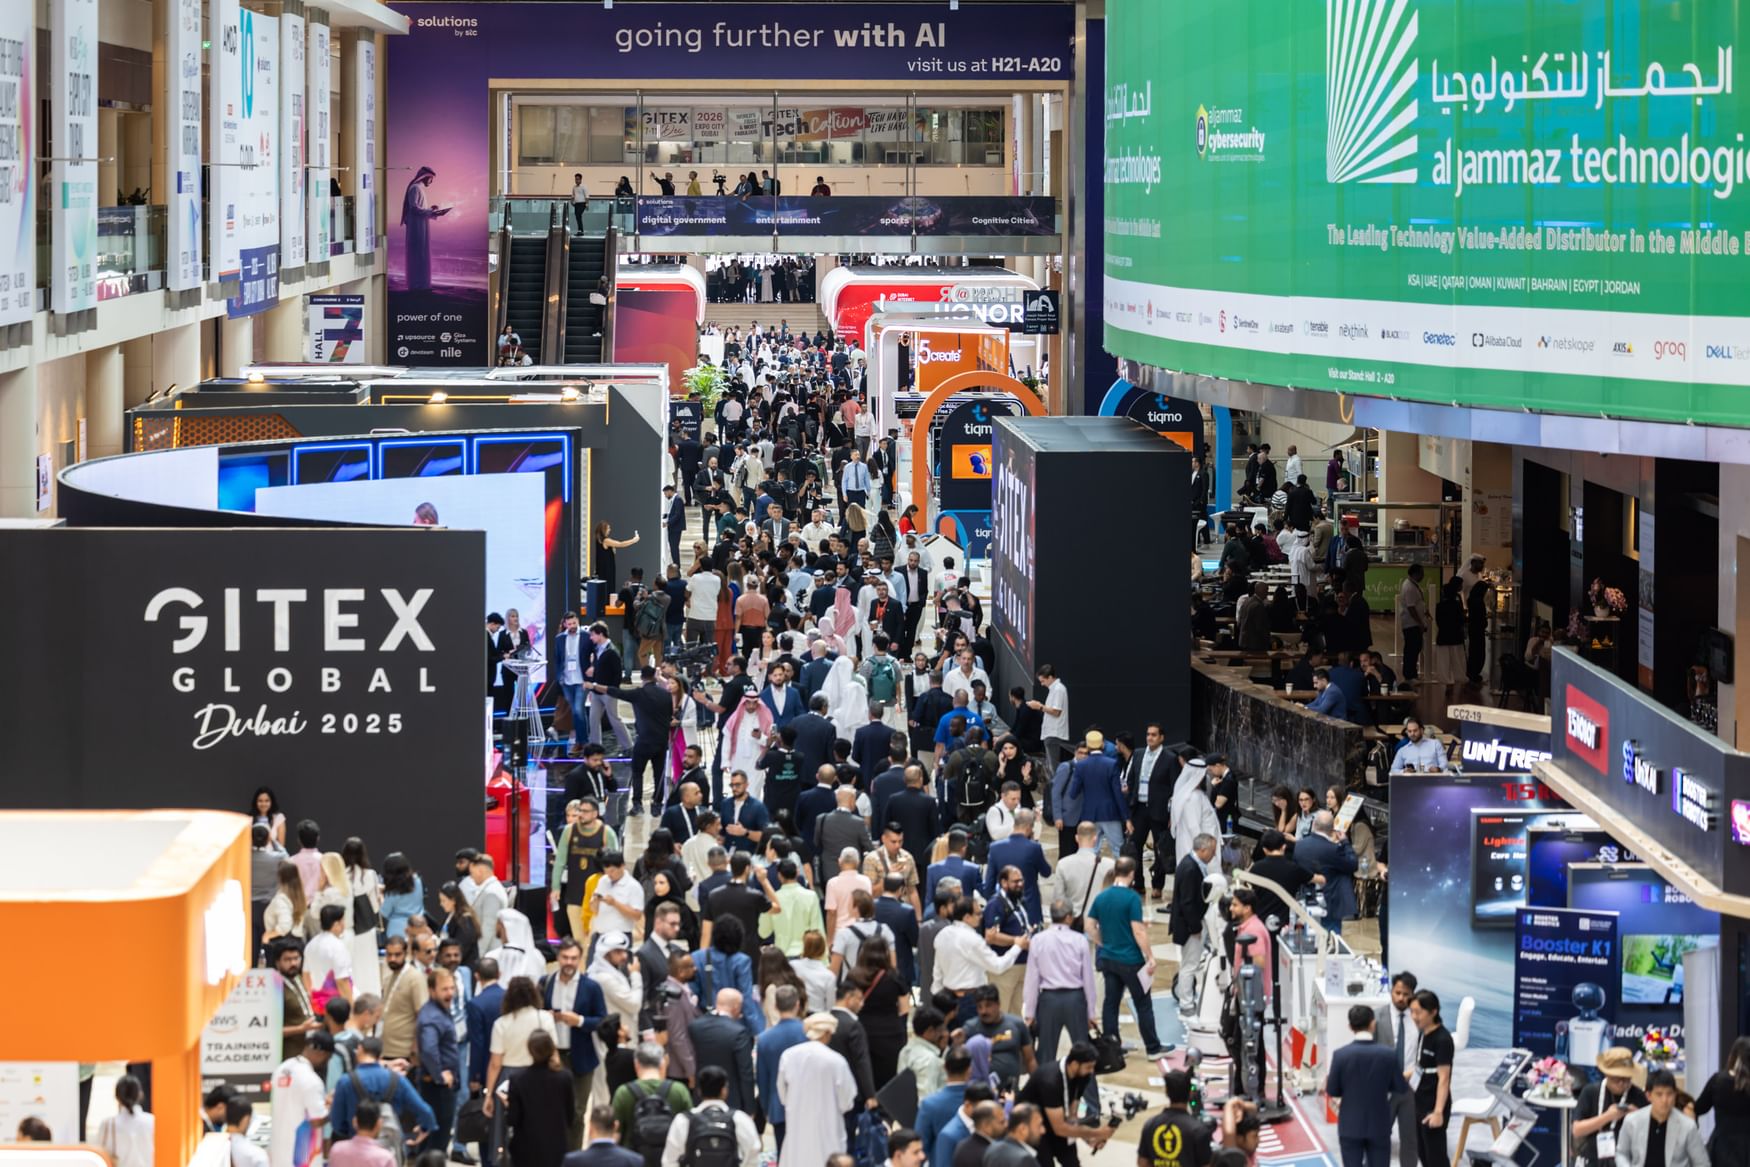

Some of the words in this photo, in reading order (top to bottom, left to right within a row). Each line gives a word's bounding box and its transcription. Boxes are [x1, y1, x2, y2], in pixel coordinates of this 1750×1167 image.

[417, 15, 478, 28] solutions
[454, 29, 464, 38] by
[465, 28, 478, 37] stc
[615, 22, 702, 53] going
[712, 23, 825, 48] further
[833, 23, 906, 48] with
[914, 23, 946, 48] AI
[907, 58, 943, 73] visit
[948, 61, 967, 73] us
[970, 59, 988, 73] at
[991, 57, 1062, 73] H21-A20
[642, 112, 688, 125] GITEX
[697, 112, 723, 122] 2026
[1208, 126, 1265, 154] cybersecurity
[642, 214, 671, 226] digital
[673, 215, 727, 226] government
[755, 215, 821, 225] entertainment
[880, 216, 909, 226] sports
[972, 215, 1009, 226] Cognitive
[1010, 215, 1035, 225] Cities
[1327, 223, 1345, 246] The
[1347, 224, 1388, 252] Leading
[1390, 225, 1455, 254] Technology
[1457, 226, 1543, 251] Value-Added
[1545, 227, 1627, 253] Distributor
[1630, 229, 1645, 253] in
[1649, 229, 1676, 254] the
[1680, 230, 1739, 255] Middle
[1424, 274, 1438, 288] UAE
[1441, 275, 1465, 289] QATAR
[1469, 276, 1492, 290] OMAN
[1496, 277, 1526, 291] KUWAIT
[1531, 278, 1568, 292] BAHRAIN
[1573, 279, 1599, 293] EGYPT
[1603, 281, 1641, 295] JORDAN
[397, 314, 428, 324] power
[430, 313, 441, 321] of
[323, 307, 363, 362] 7
[1423, 331, 1457, 346] Genetec
[314, 329, 323, 359] HALL
[1506, 336, 1522, 348] Cloud
[1553, 338, 1594, 352] netskope
[440, 347, 462, 358] nile
[1654, 341, 1686, 361] groq
[1706, 345, 1733, 359] DELL
[1147, 411, 1183, 425] tiqmo
[963, 424, 992, 436] tiqm
[998, 462, 1027, 577] GITEX
[975, 527, 992, 538] tiq
[999, 576, 1026, 640] GLOBAL
[144, 587, 436, 653] GITEX
[172, 667, 436, 692] GLOBAL
[1453, 708, 1482, 722] CC2-19
[192, 703, 307, 750] Dubai
[321, 713, 402, 734] 2025
[1521, 934, 1588, 955] Booster
[1592, 939, 1611, 956] K1
[1520, 951, 1547, 962] Engage,
[1547, 953, 1577, 964] Educate,
[1577, 955, 1608, 966] Entertain
[248, 1015, 268, 1028] AI
[207, 1042, 270, 1052] TRAINING
[205, 1053, 271, 1063] ACADEMY
